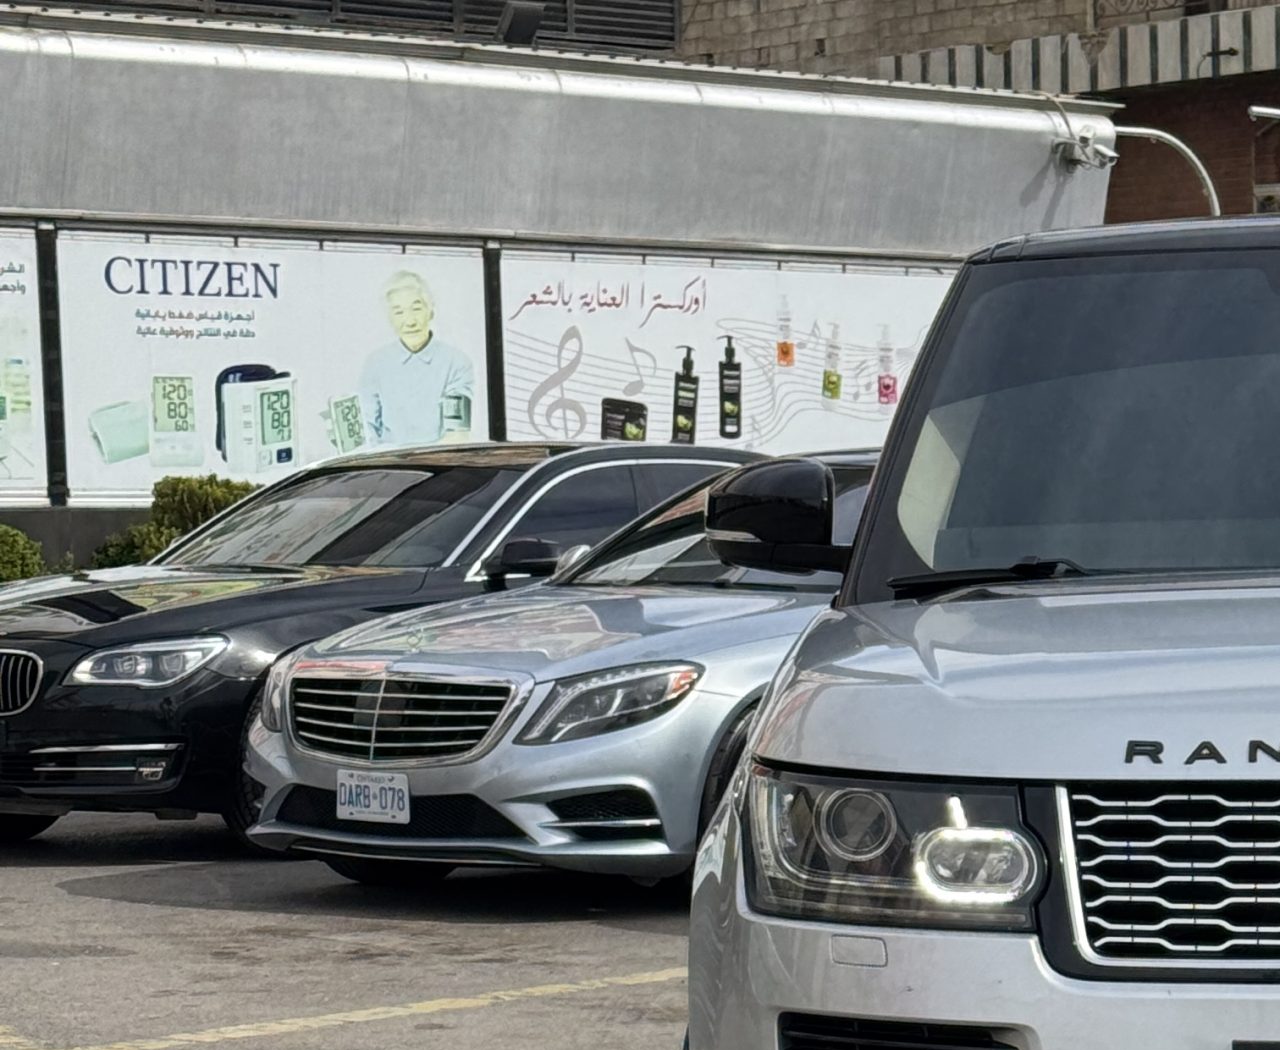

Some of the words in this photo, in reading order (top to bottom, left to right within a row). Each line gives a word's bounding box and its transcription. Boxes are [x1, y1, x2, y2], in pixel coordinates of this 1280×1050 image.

[104, 256, 280, 299] CITIZEN
[509, 279, 573, 321] بالشعر
[579, 280, 629, 314] العناية
[639, 276, 706, 328] أوركسترا
[194, 310, 222, 321] قياس
[224, 309, 255, 323] أجهزة
[223, 328, 237, 339] في
[162, 384, 187, 401] 120
[267, 391, 290, 411] 120
[167, 401, 188, 419] 80
[271, 410, 291, 430] 80
[175, 419, 189, 432] 60
[347, 419, 361, 439] 80
[339, 782, 371, 809] DARB
[379, 785, 405, 812] 078
